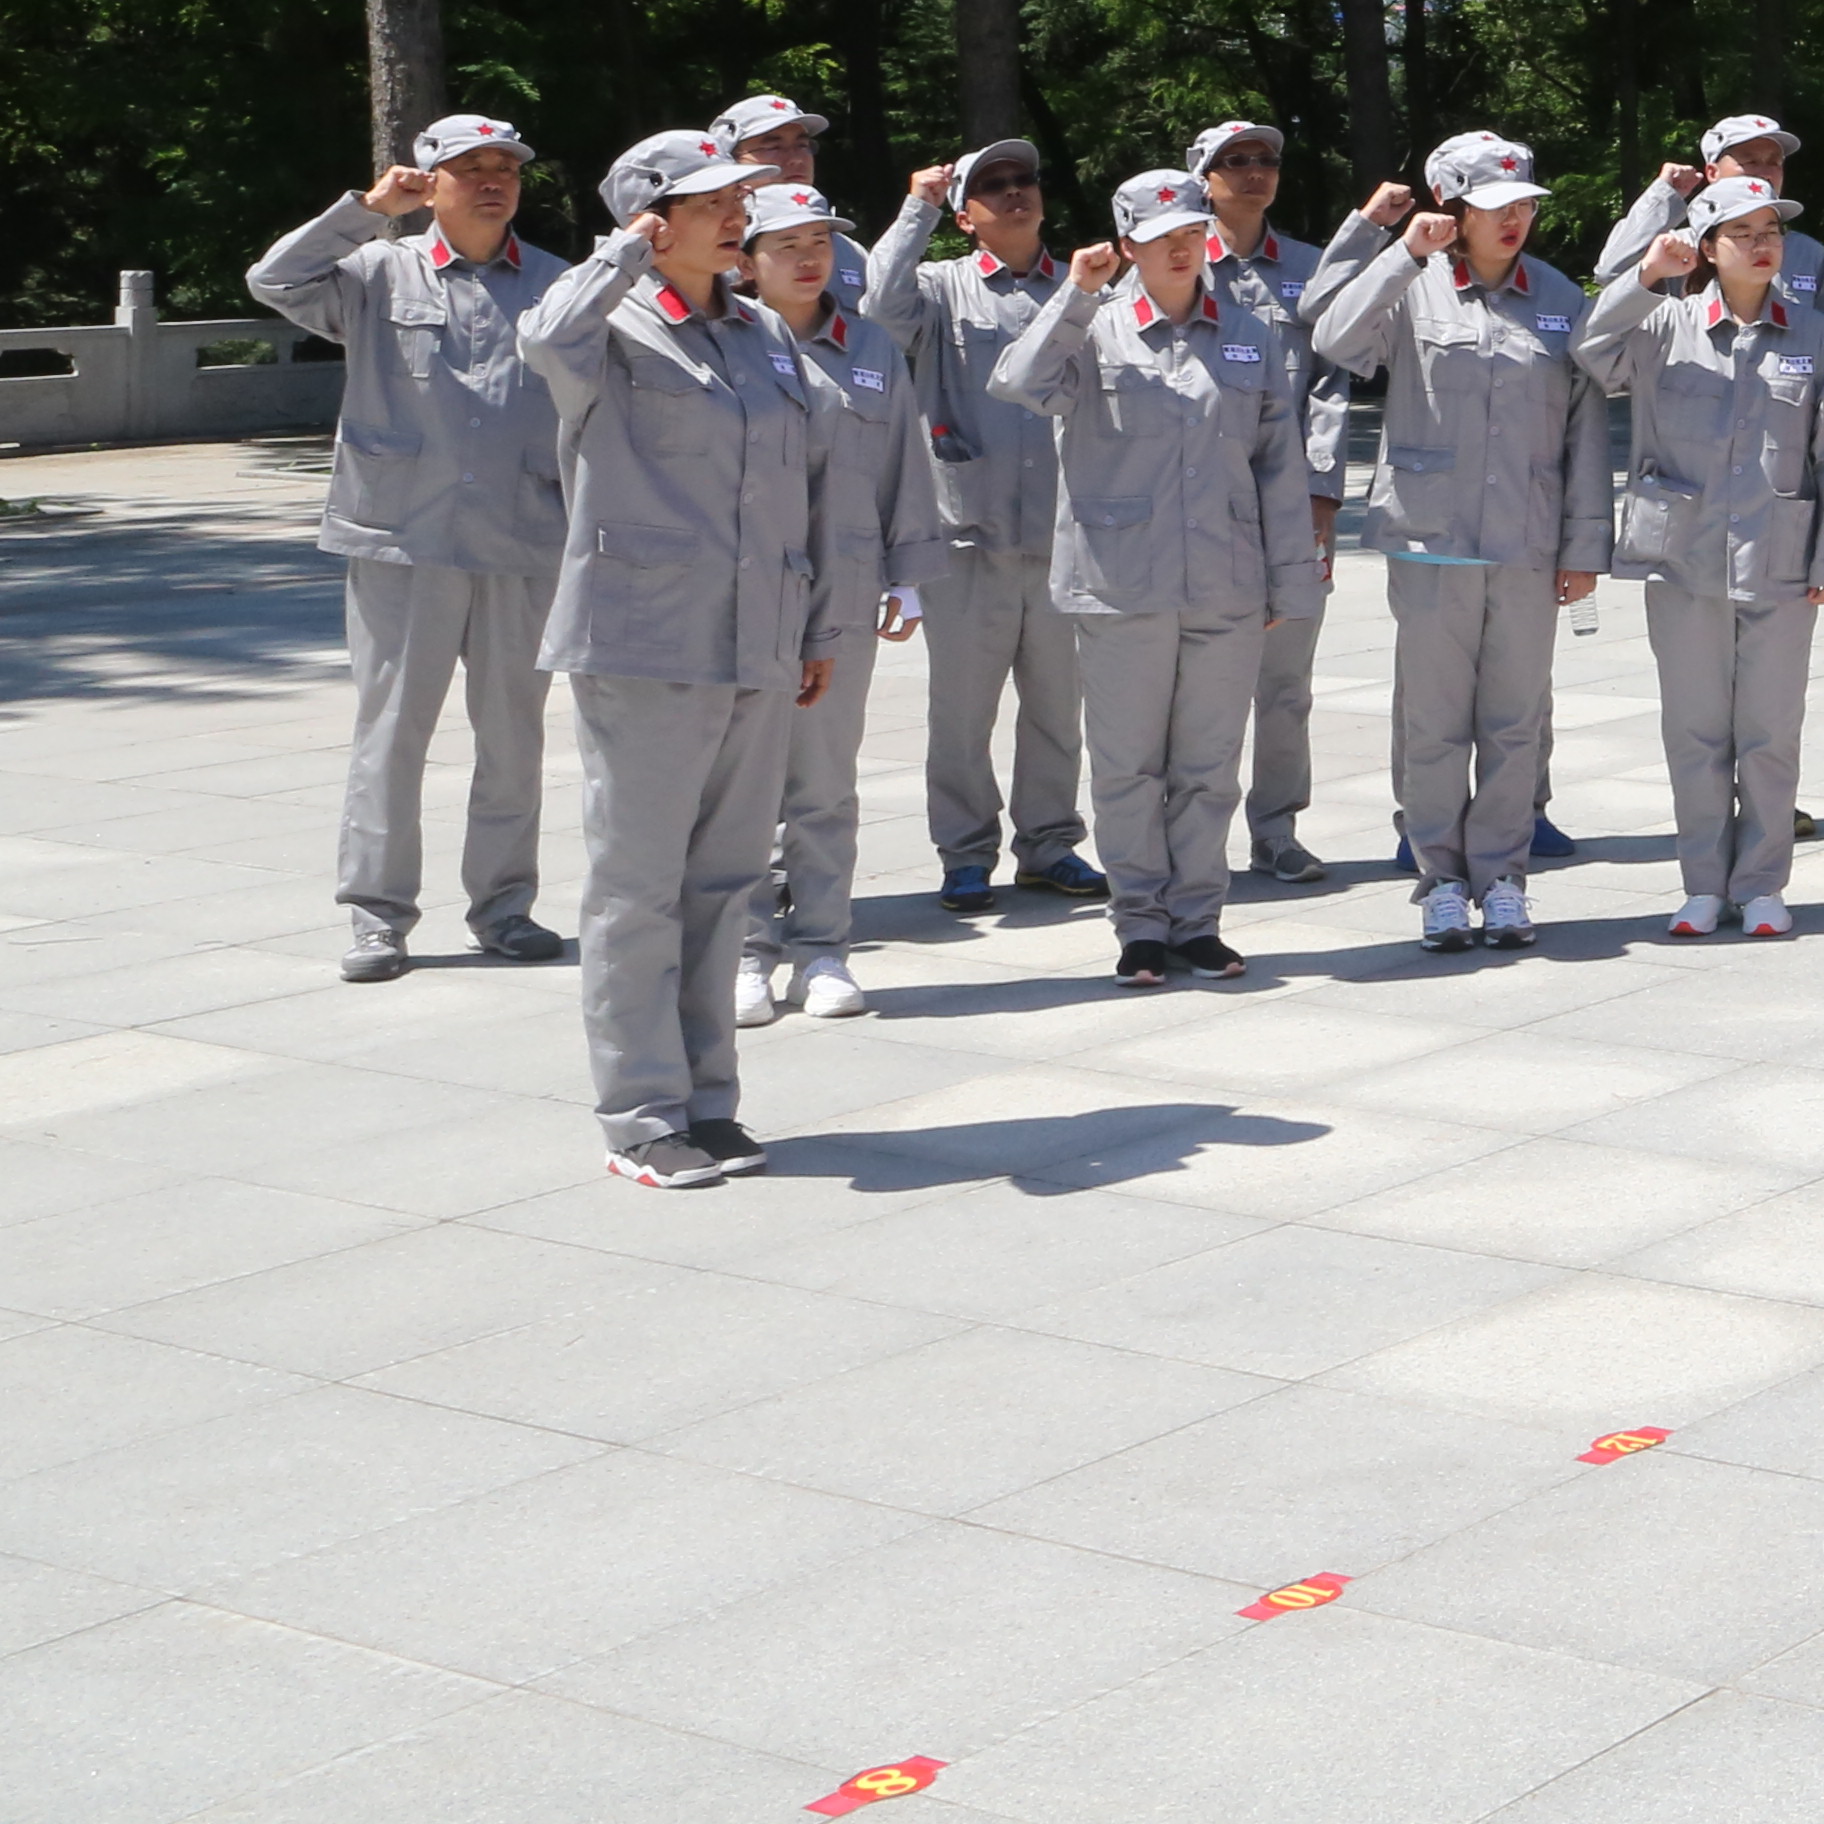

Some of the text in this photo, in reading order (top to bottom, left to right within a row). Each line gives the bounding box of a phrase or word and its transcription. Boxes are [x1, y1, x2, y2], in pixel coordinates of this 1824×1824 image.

[1599, 1433, 1657, 1451] 12
[1268, 1583, 1335, 1607] 10
[855, 1769, 917, 1796] 8
